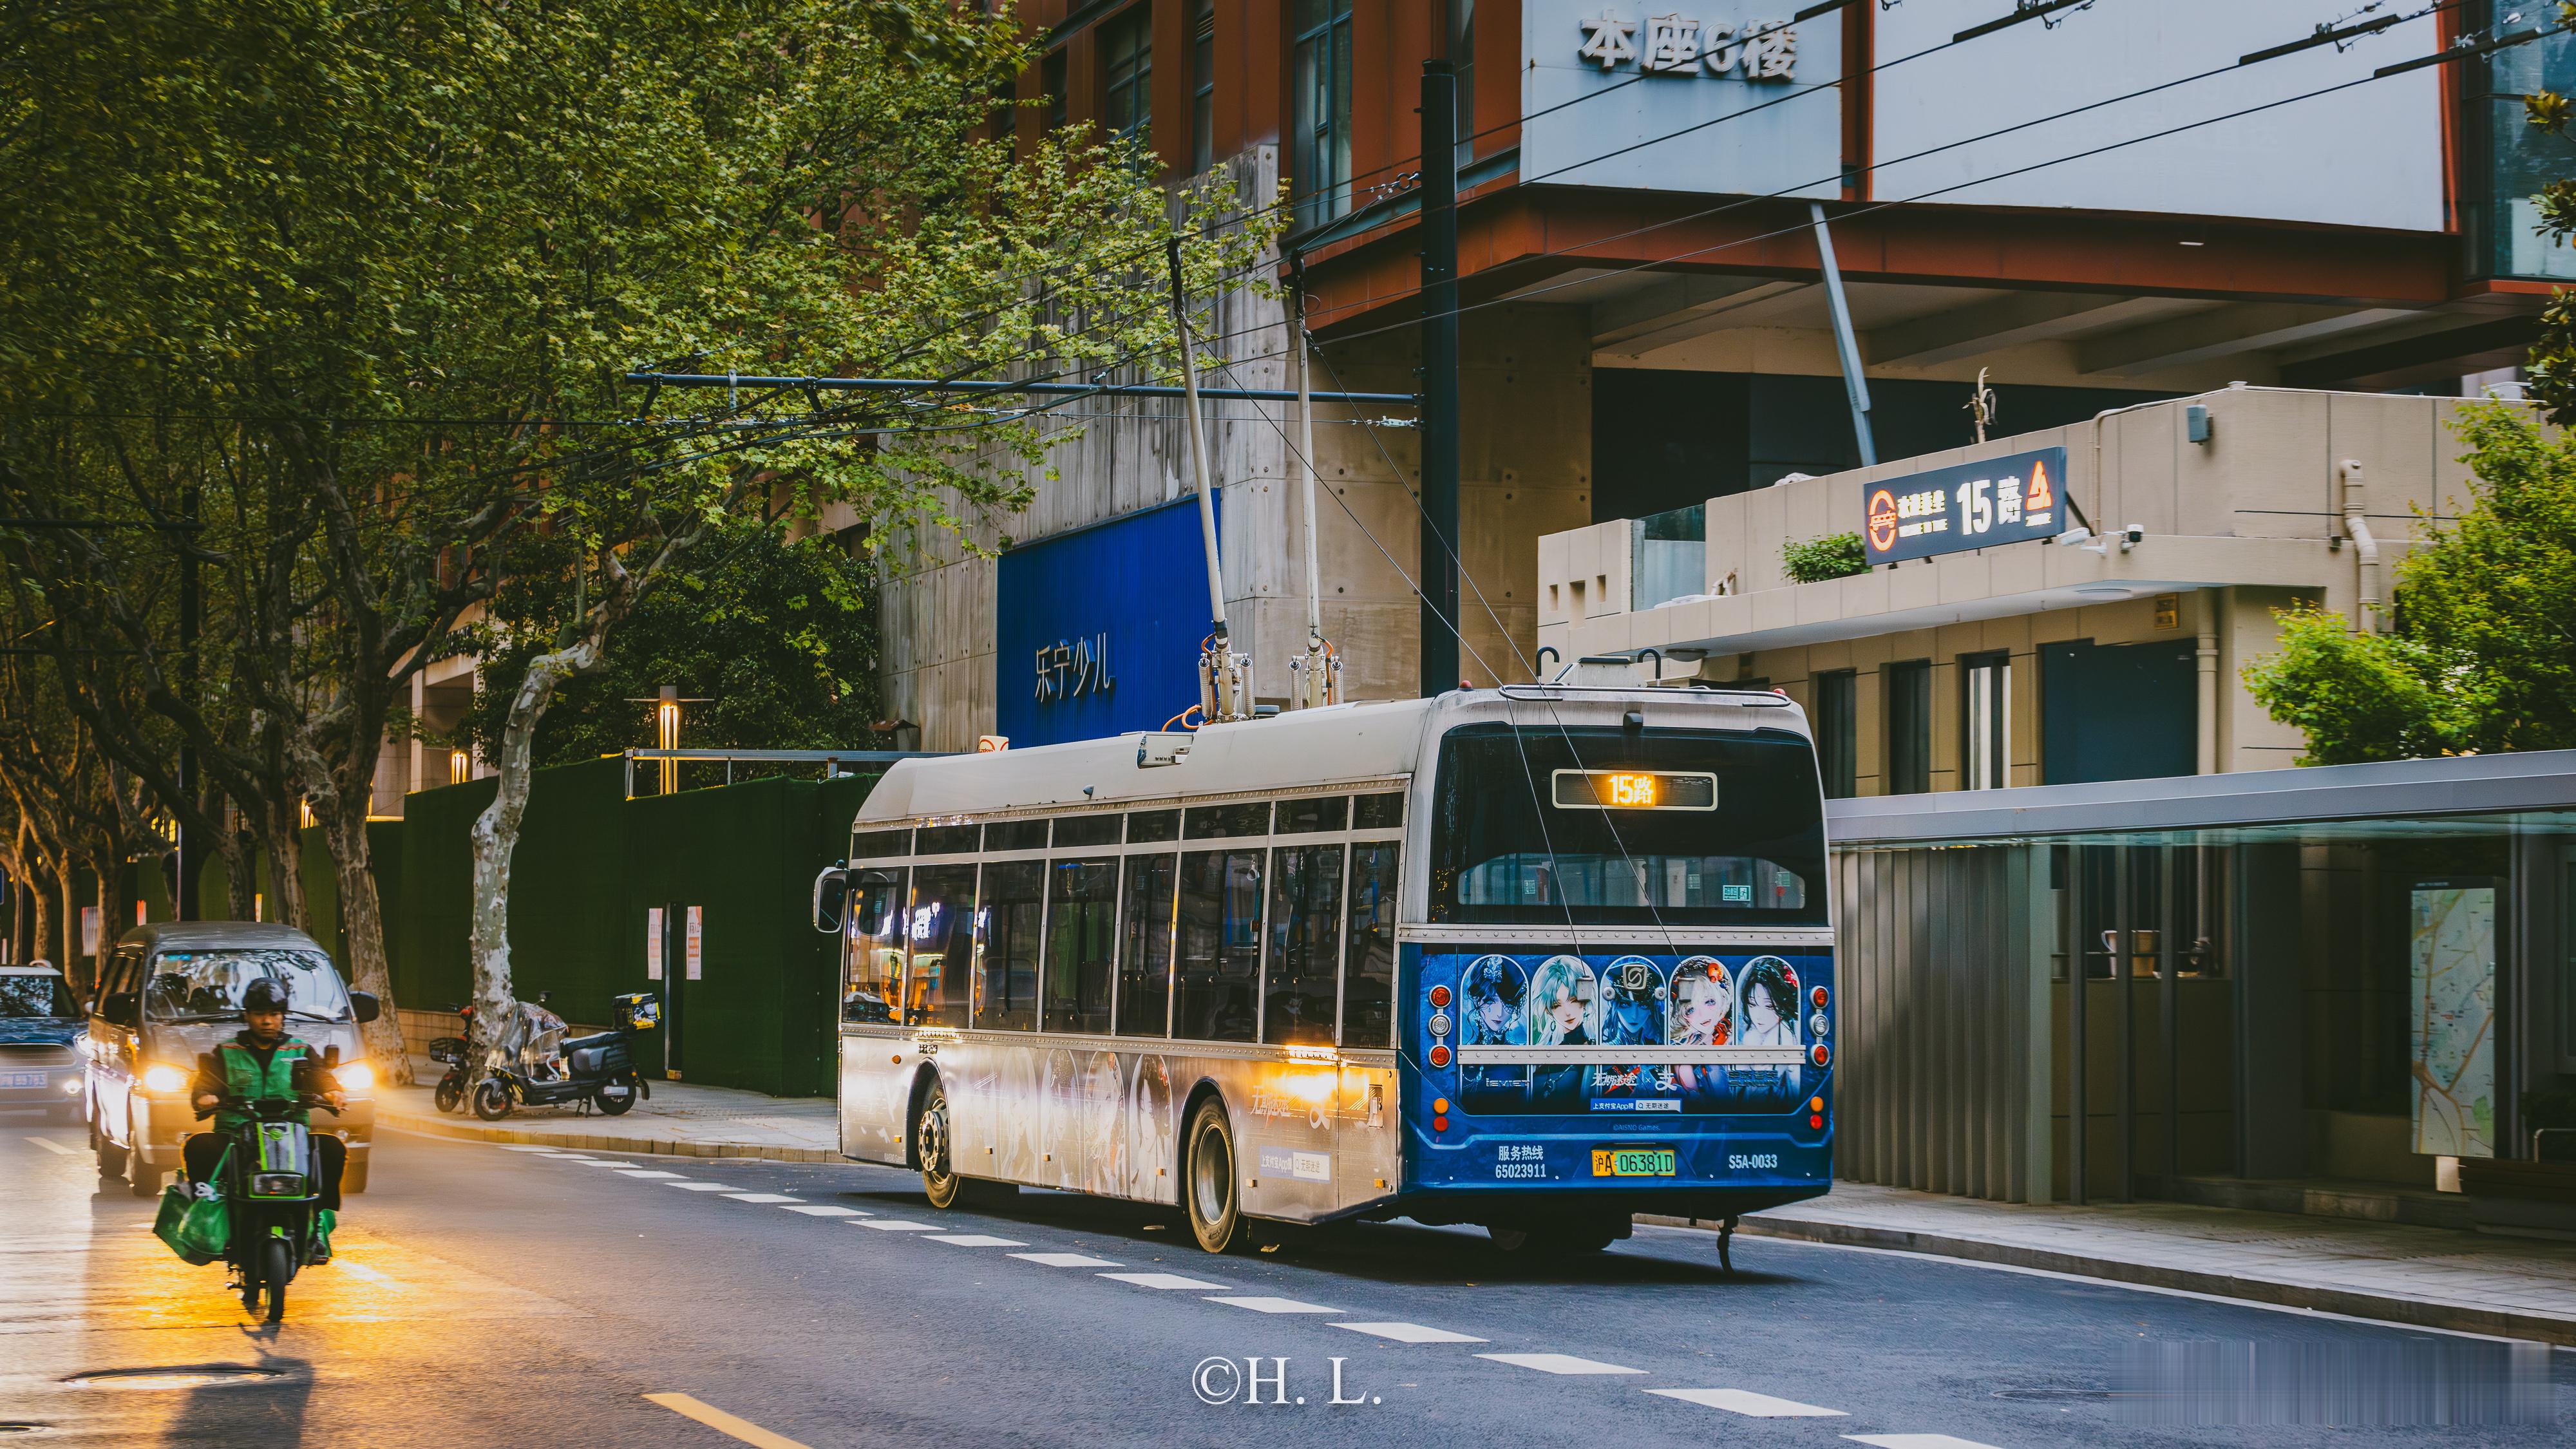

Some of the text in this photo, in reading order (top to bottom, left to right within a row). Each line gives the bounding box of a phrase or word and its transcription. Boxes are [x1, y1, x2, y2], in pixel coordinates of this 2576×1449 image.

[1577, 8, 1797, 80] 本座6楼
[1035, 632, 1116, 703] 乐宁少儿
[1608, 775, 1654, 804] 15路
[1591, 1072, 1637, 1088] 无期迷途
[1498, 1145, 1544, 1161] 服务热线
[1728, 1153, 1778, 1169] S5A-0033
[1495, 1164, 1546, 1179] 65023911
